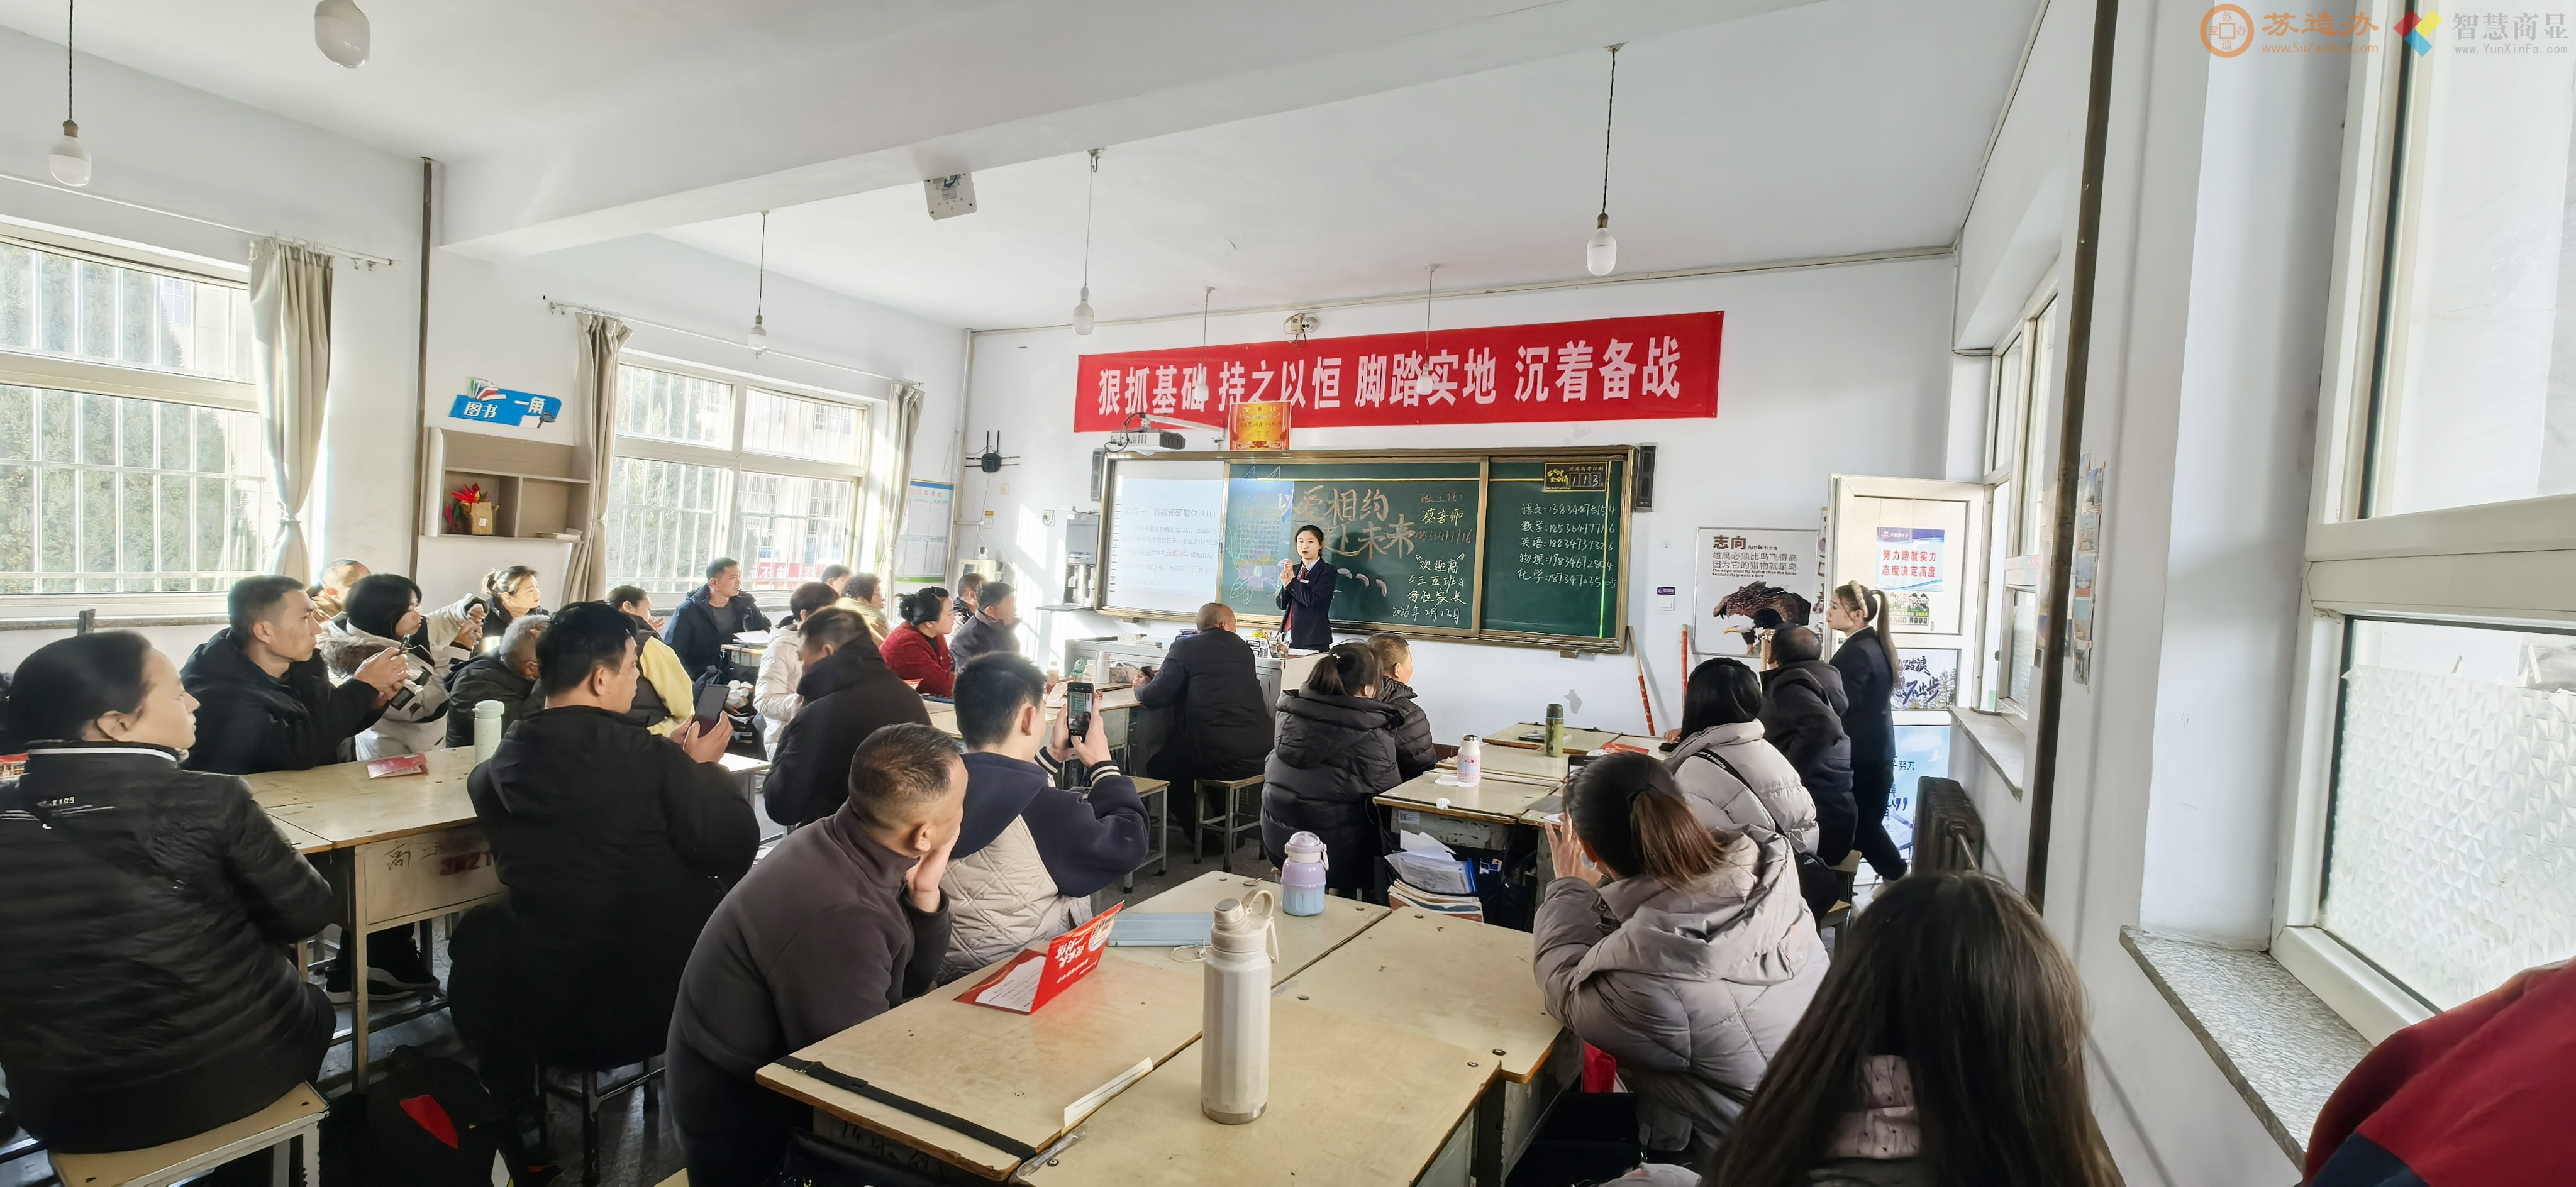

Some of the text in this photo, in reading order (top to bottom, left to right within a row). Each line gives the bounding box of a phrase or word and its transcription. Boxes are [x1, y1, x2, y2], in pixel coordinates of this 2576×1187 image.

[1097, 336, 1680, 416] 狠抓基础 持之以恒 脚踏实地 沉着备战
[464, 396, 545, 418] 图书 一角
[1713, 535, 1746, 550] 志向
[1882, 549, 1936, 562] 努力造就实力
[1713, 561, 1797, 571] 因为它的猎物就是鸟
[1882, 565, 1936, 577] 态度决定高度
